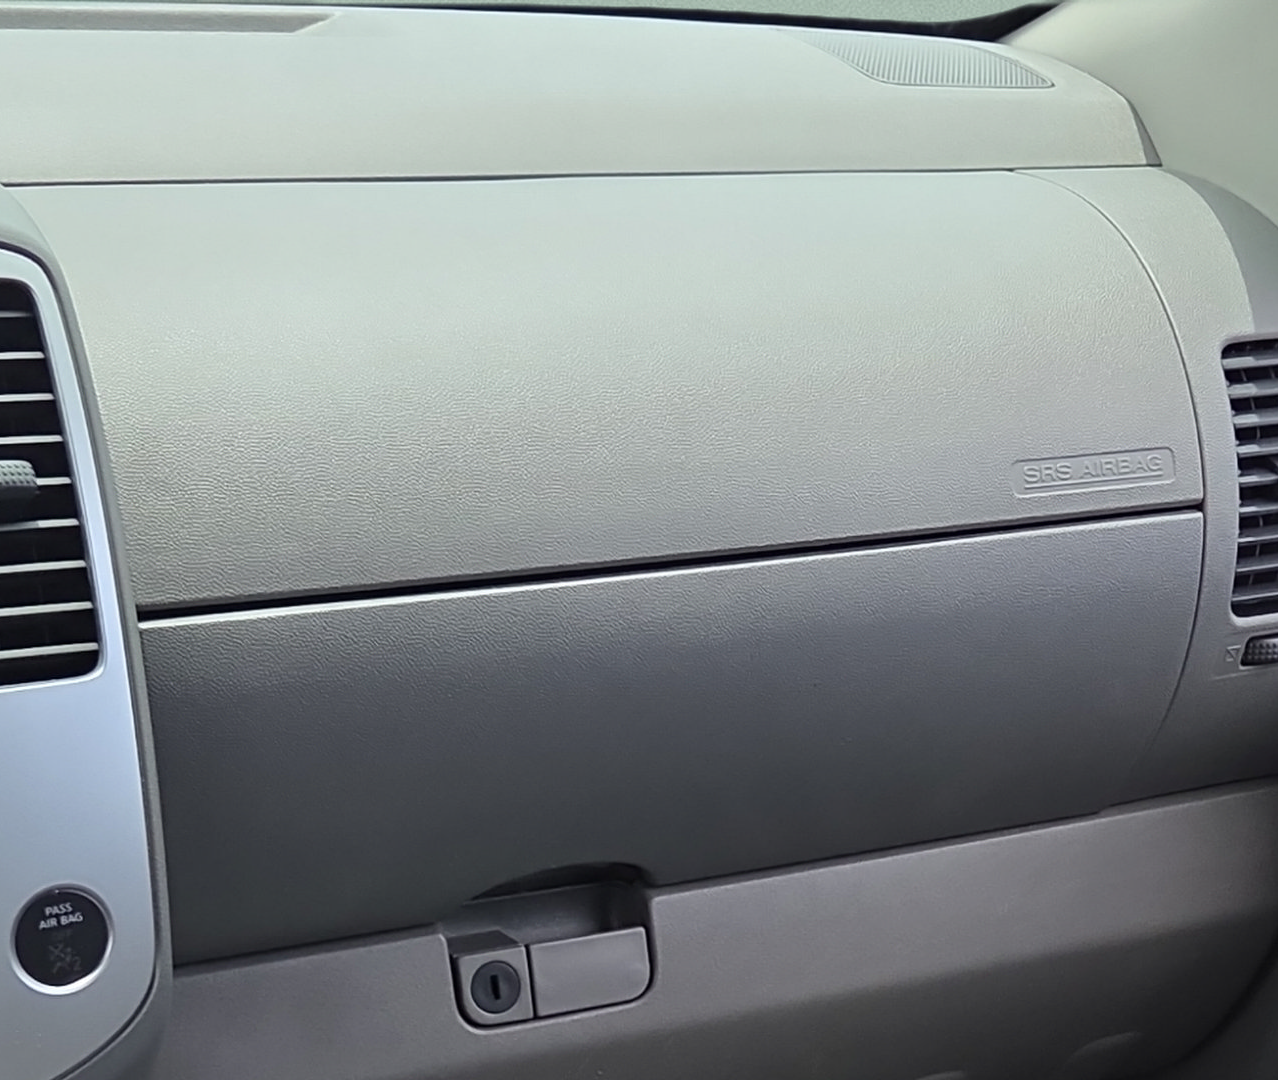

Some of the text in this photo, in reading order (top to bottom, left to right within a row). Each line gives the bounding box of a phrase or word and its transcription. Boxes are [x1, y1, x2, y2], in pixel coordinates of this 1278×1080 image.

[1022, 454, 1163, 484] SRS AIRBAG
[44, 902, 73, 917] PASS
[38, 912, 83, 930] AIR BAG
